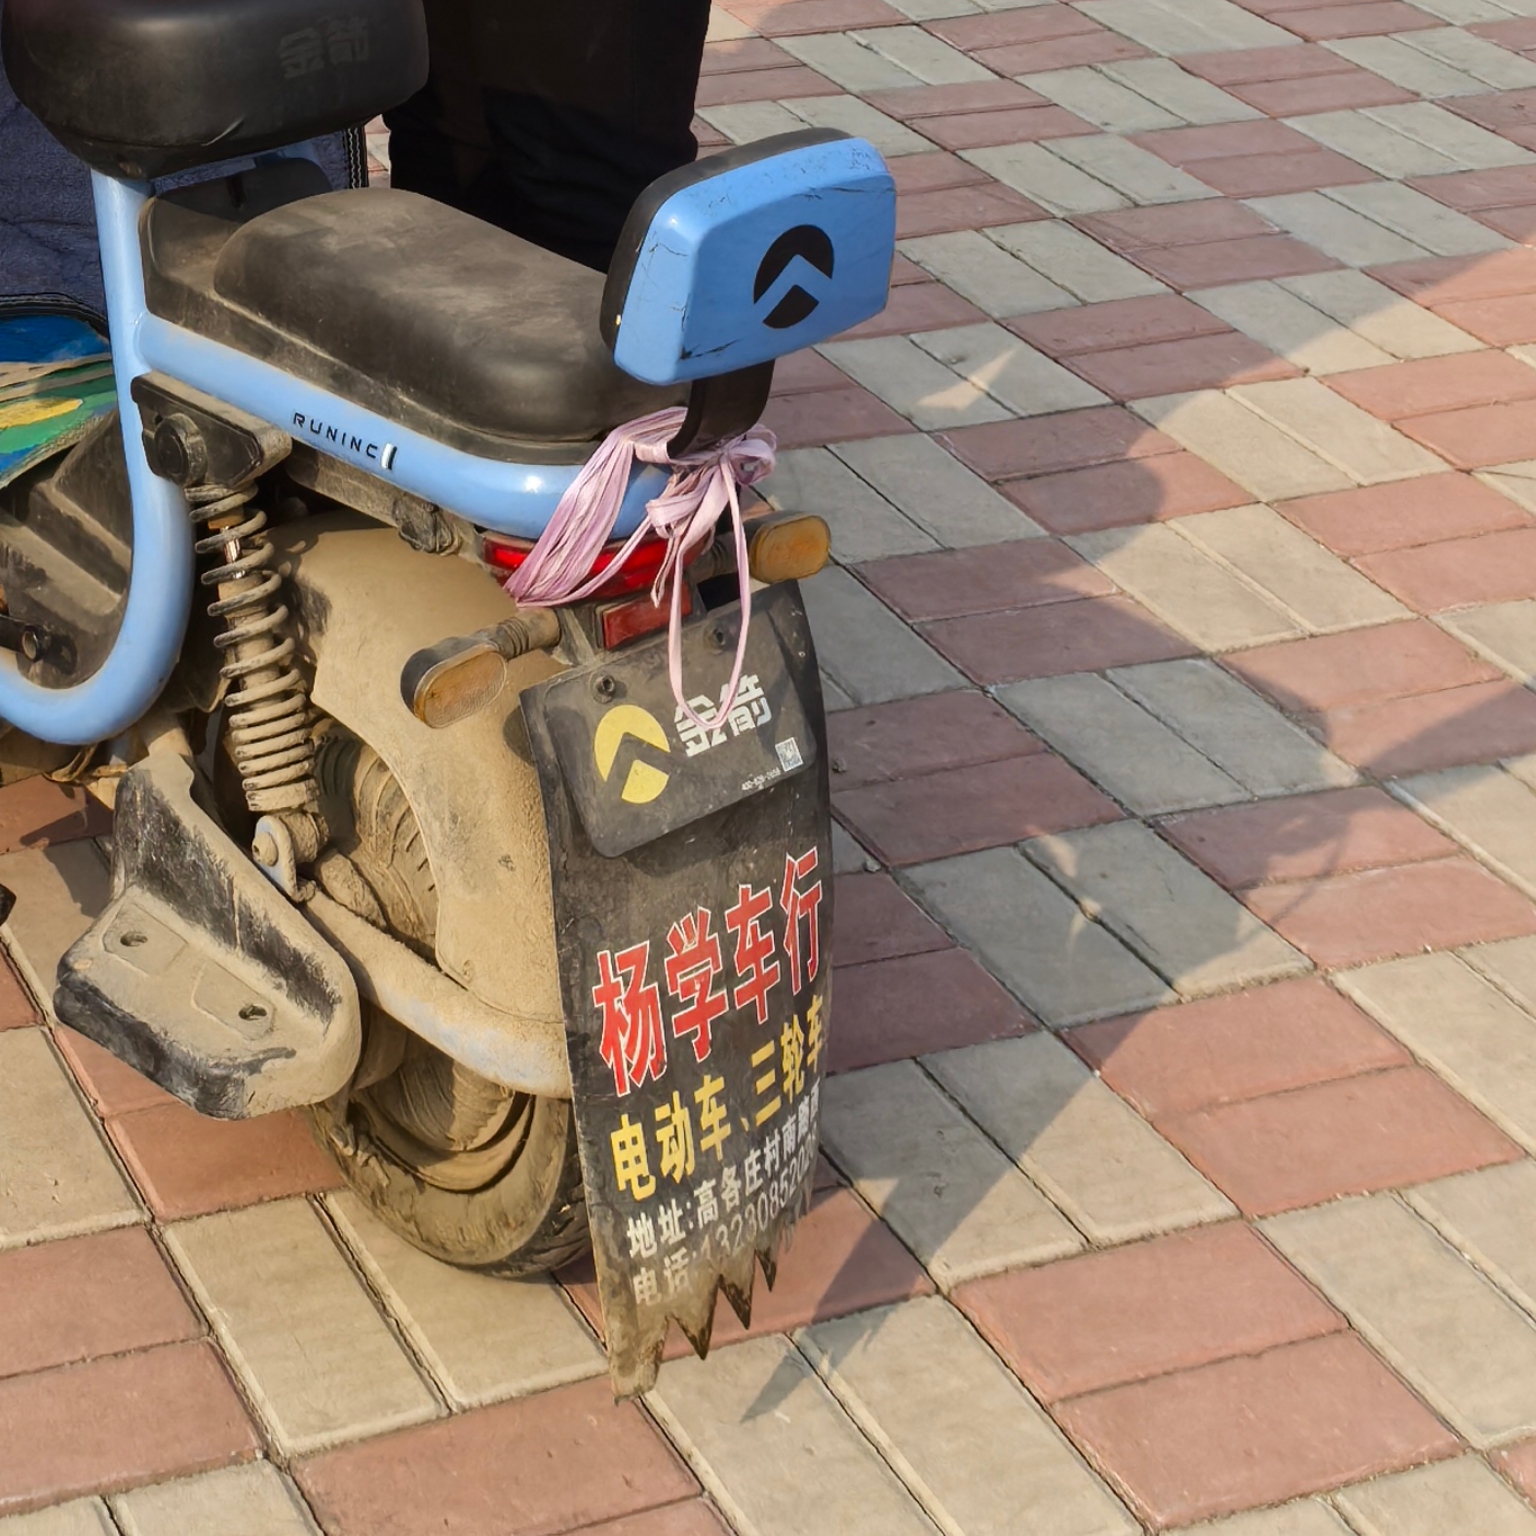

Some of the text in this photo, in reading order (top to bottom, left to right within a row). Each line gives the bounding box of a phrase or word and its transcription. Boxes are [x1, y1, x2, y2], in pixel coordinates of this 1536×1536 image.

[674, 674, 772, 757] 金箭
[592, 846, 823, 1097] 杨学车行
